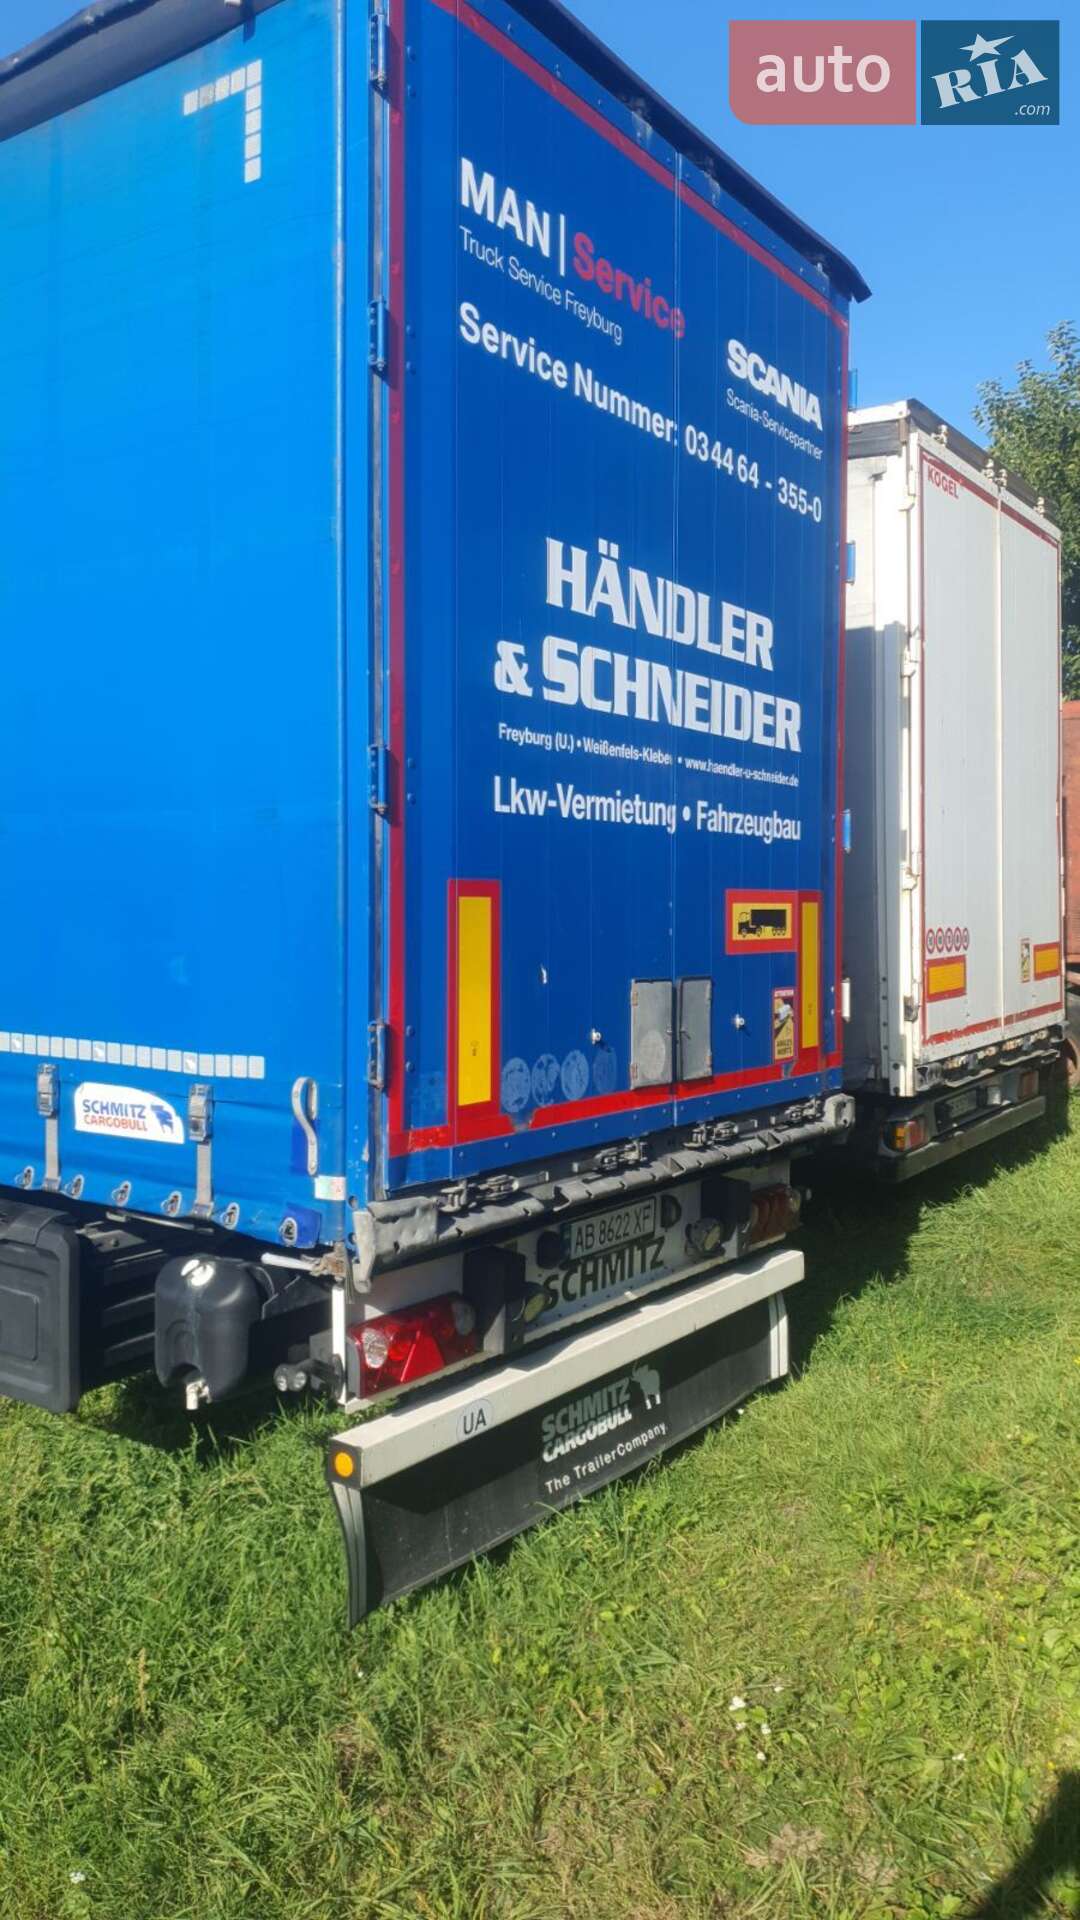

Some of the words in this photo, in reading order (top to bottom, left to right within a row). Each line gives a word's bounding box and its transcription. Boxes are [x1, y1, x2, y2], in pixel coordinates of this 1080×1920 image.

[460, 157, 550, 258] MAN
[573, 231, 686, 339] Service
[459, 225, 504, 272] Truck
[508, 256, 562, 305] Service
[565, 289, 623, 346] Freyburg
[459, 302, 568, 389] Service
[574, 361, 679, 447] Nummer:
[727, 338, 823, 432] SCANIA
[726, 388, 823, 461] Scania-Servicepartner
[546, 537, 774, 672] HÄNDLER
[494, 640, 533, 697] &
[542, 635, 802, 753] SCHNEIDER
[498, 722, 552, 750] Freyburg
[555, 732, 575, 754] (U.)
[494, 775, 677, 834] Lkw-Vermietung
[696, 800, 802, 844] Fahrzeugbau
[82, 1099, 148, 1120] SCHMITZ
[83, 1114, 148, 1132] CARGOBULL
[574, 1224, 596, 1254] AB
[598, 1212, 630, 1246] 8622
[542, 1235, 666, 1313] SCHMITZ
[463, 1408, 487, 1434] UA
[541, 1376, 631, 1443] SCHMITZ
[541, 1403, 633, 1463] CARGOBULL
[545, 1474, 571, 1495] The
